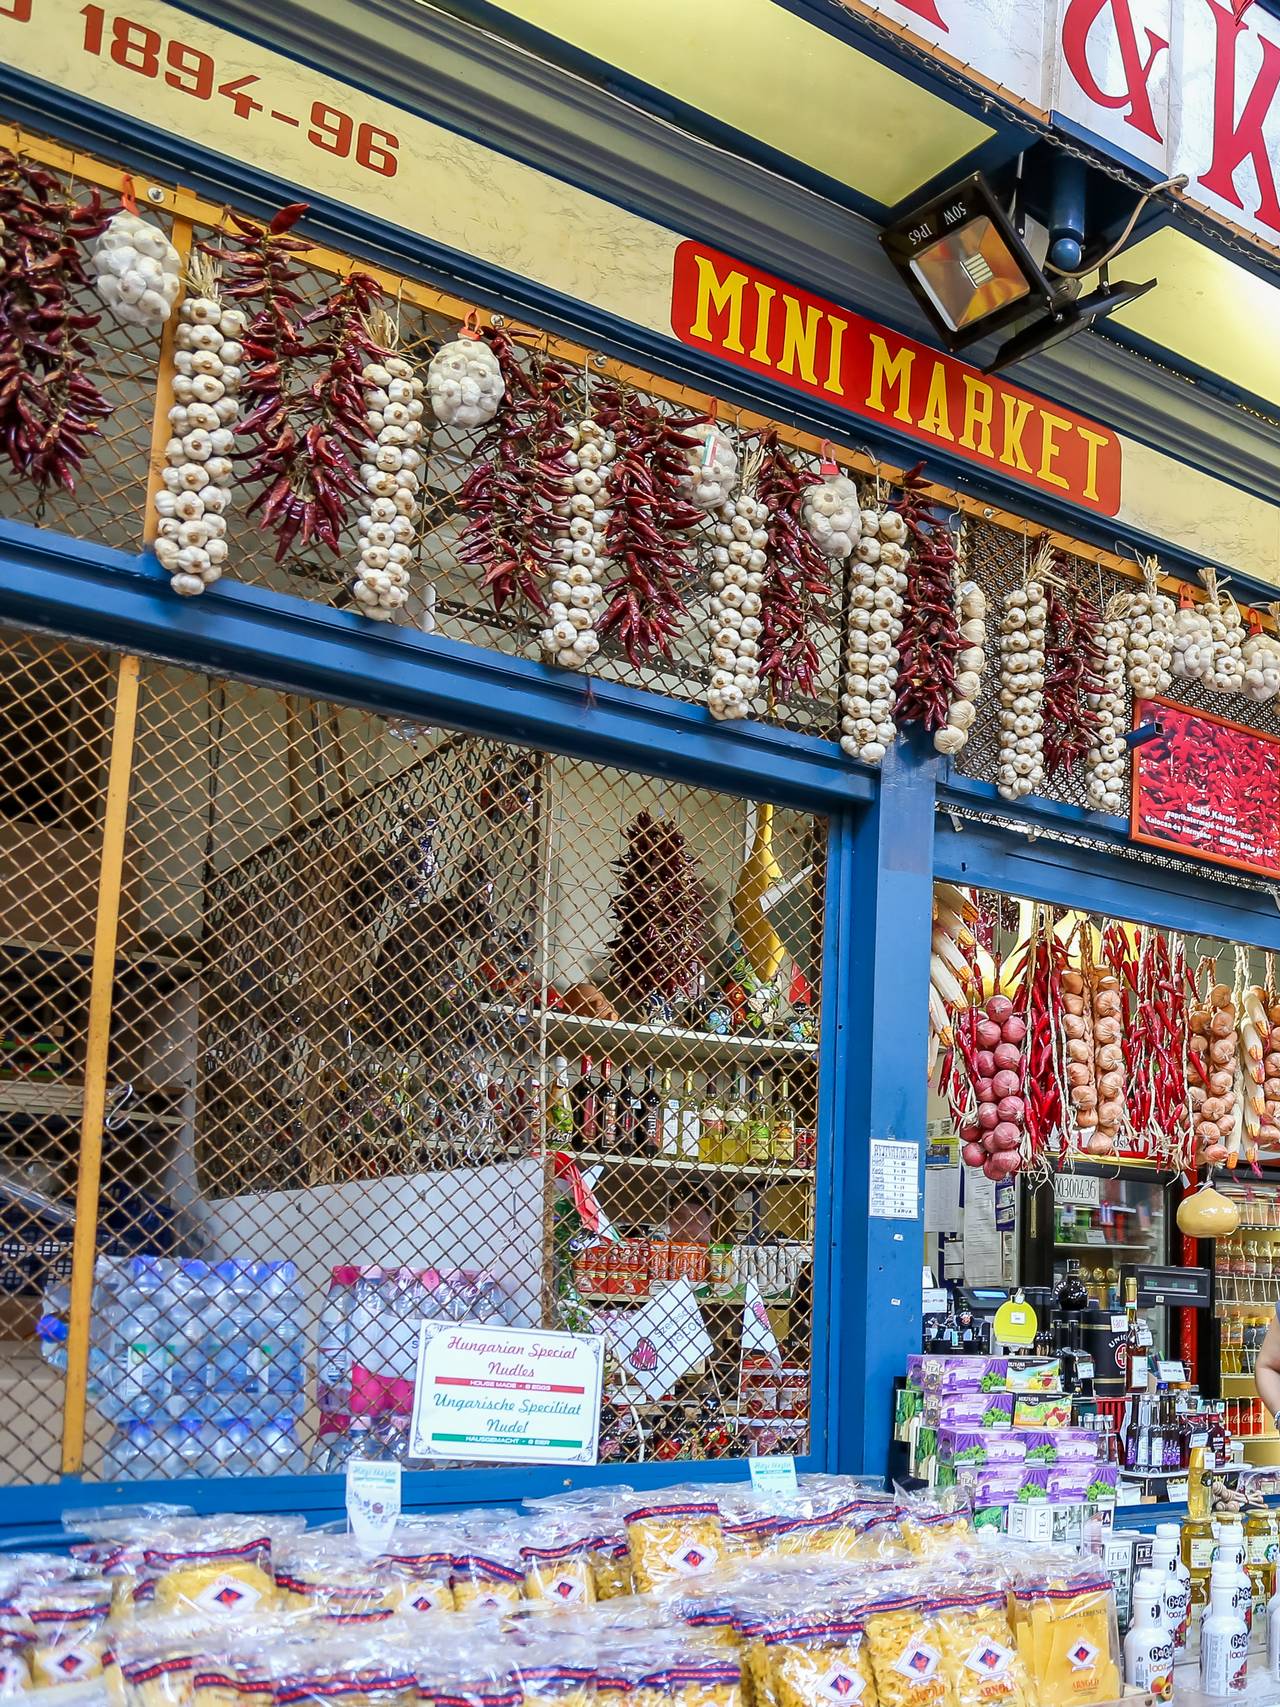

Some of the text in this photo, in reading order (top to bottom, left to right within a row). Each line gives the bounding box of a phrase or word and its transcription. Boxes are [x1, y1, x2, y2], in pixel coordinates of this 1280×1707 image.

[81, 3, 399, 178] 1894-96
[907, 223, 933, 246] IP65
[689, 254, 1109, 502] MINI MARKET
[447, 1335, 578, 1360] Hungarian Special
[487, 1361, 535, 1378] Nudles
[433, 1393, 516, 1411] Ungarische
[486, 1418, 530, 1433] Nudel
[1110, 1551, 1128, 1561] TEA
